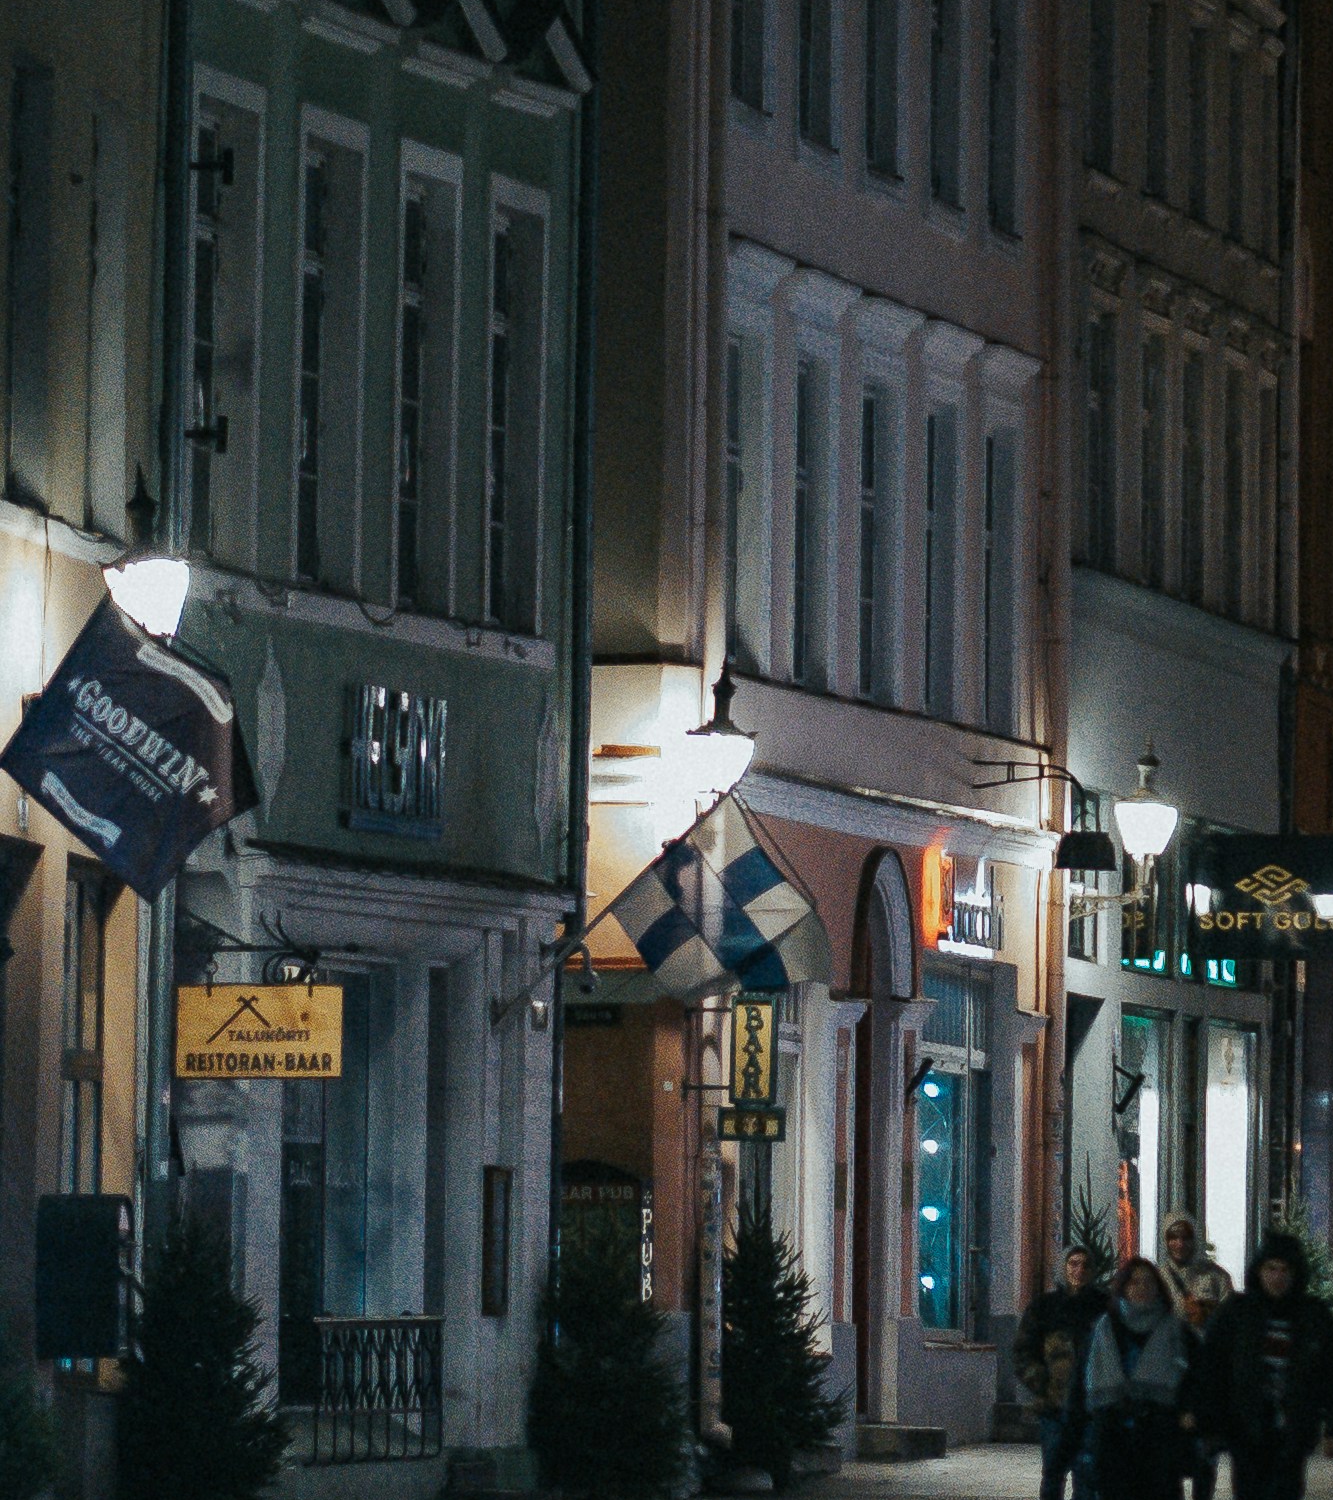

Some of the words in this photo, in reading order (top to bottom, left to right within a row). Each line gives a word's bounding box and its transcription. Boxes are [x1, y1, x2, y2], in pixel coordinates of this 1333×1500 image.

[70, 723, 94, 747] THE
[75, 679, 209, 795] GOODWIN
[1199, 911, 1267, 931] SOFT
[185, 1052, 332, 1072] RESTORAN-BAAR
[742, 1006, 763, 1098] BAAR
[598, 1185, 634, 1200] PUB
[641, 1207, 653, 1303] PUB
